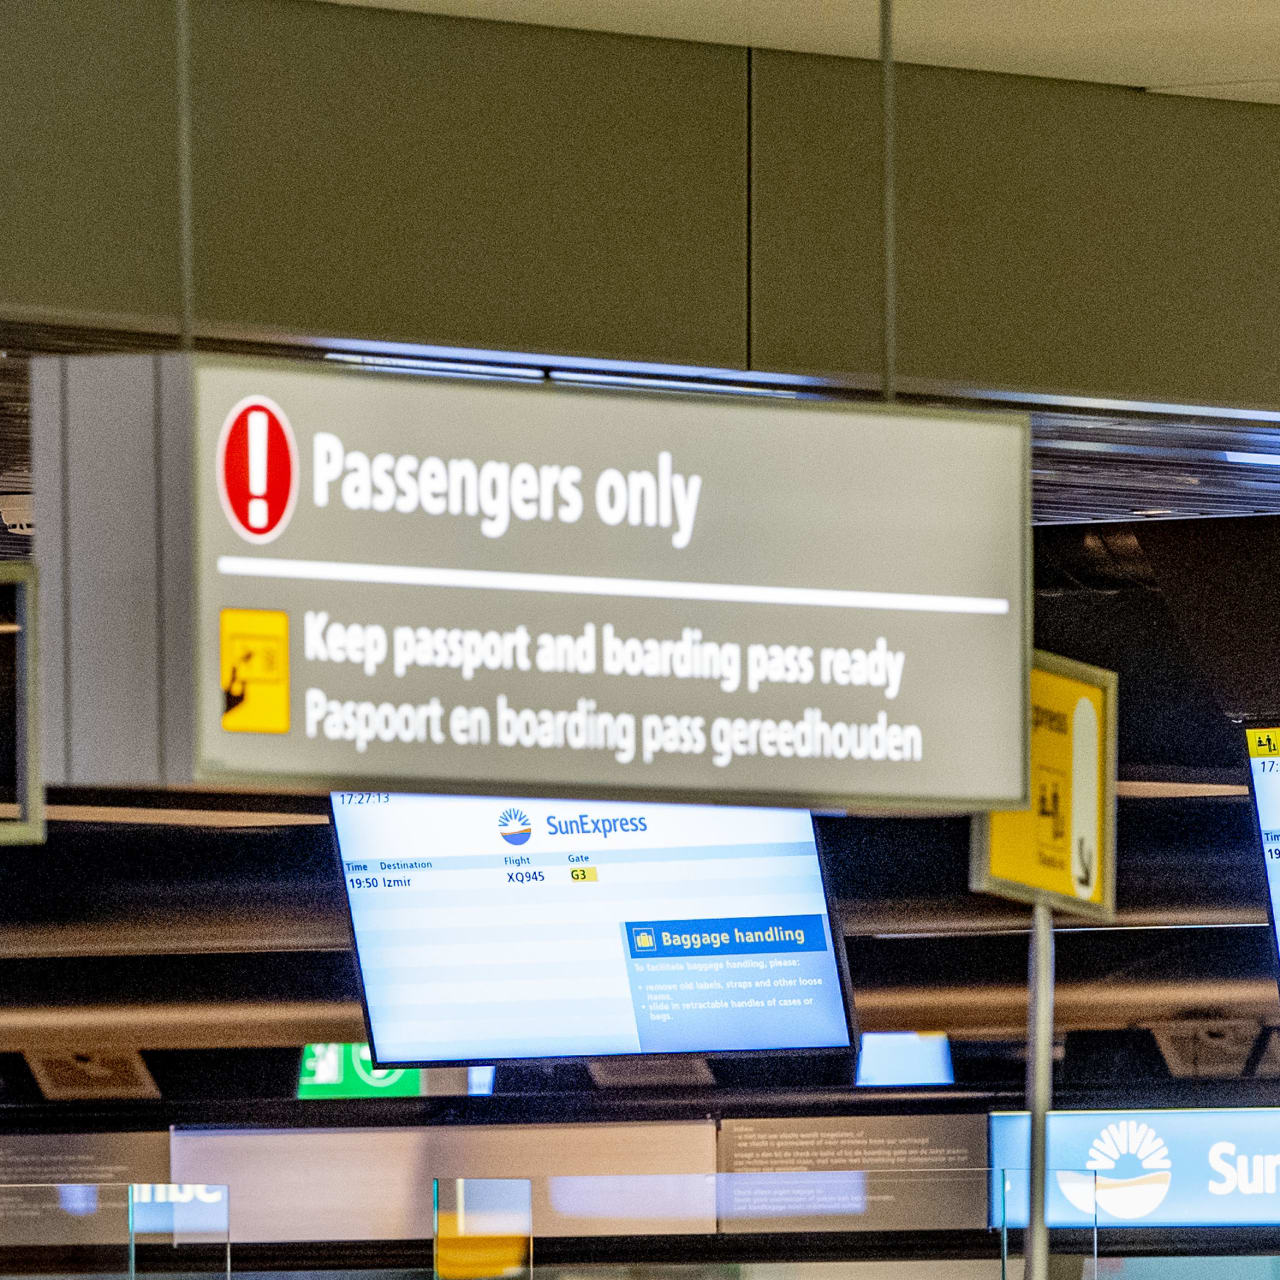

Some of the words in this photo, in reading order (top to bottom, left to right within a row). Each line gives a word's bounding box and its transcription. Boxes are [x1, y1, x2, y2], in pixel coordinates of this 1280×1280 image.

[313, 432, 583, 538] Passengers
[595, 451, 702, 549] only
[304, 611, 387, 677] Keep
[394, 624, 531, 681] passport
[536, 622, 596, 674] and
[602, 622, 741, 693] boarding
[747, 643, 814, 694] pass
[820, 636, 905, 699] ready
[305, 687, 445, 753] Paspoort
[449, 705, 490, 745] en
[496, 694, 636, 764] boarding
[642, 714, 706, 764] pass
[711, 707, 923, 768] gereedhouden
[339, 792, 391, 805] 17:27:13
[546, 813, 648, 840] SunExpress
[346, 862, 368, 872] Time
[380, 860, 433, 871] Destination
[504, 856, 531, 867] Flight
[568, 853, 590, 864] Gate
[349, 877, 378, 889] 19:50
[382, 876, 412, 888] Izmir
[507, 871, 545, 884] XQ945
[570, 869, 587, 881] G3
[661, 931, 730, 949] Baggage
[734, 927, 805, 945] handling
